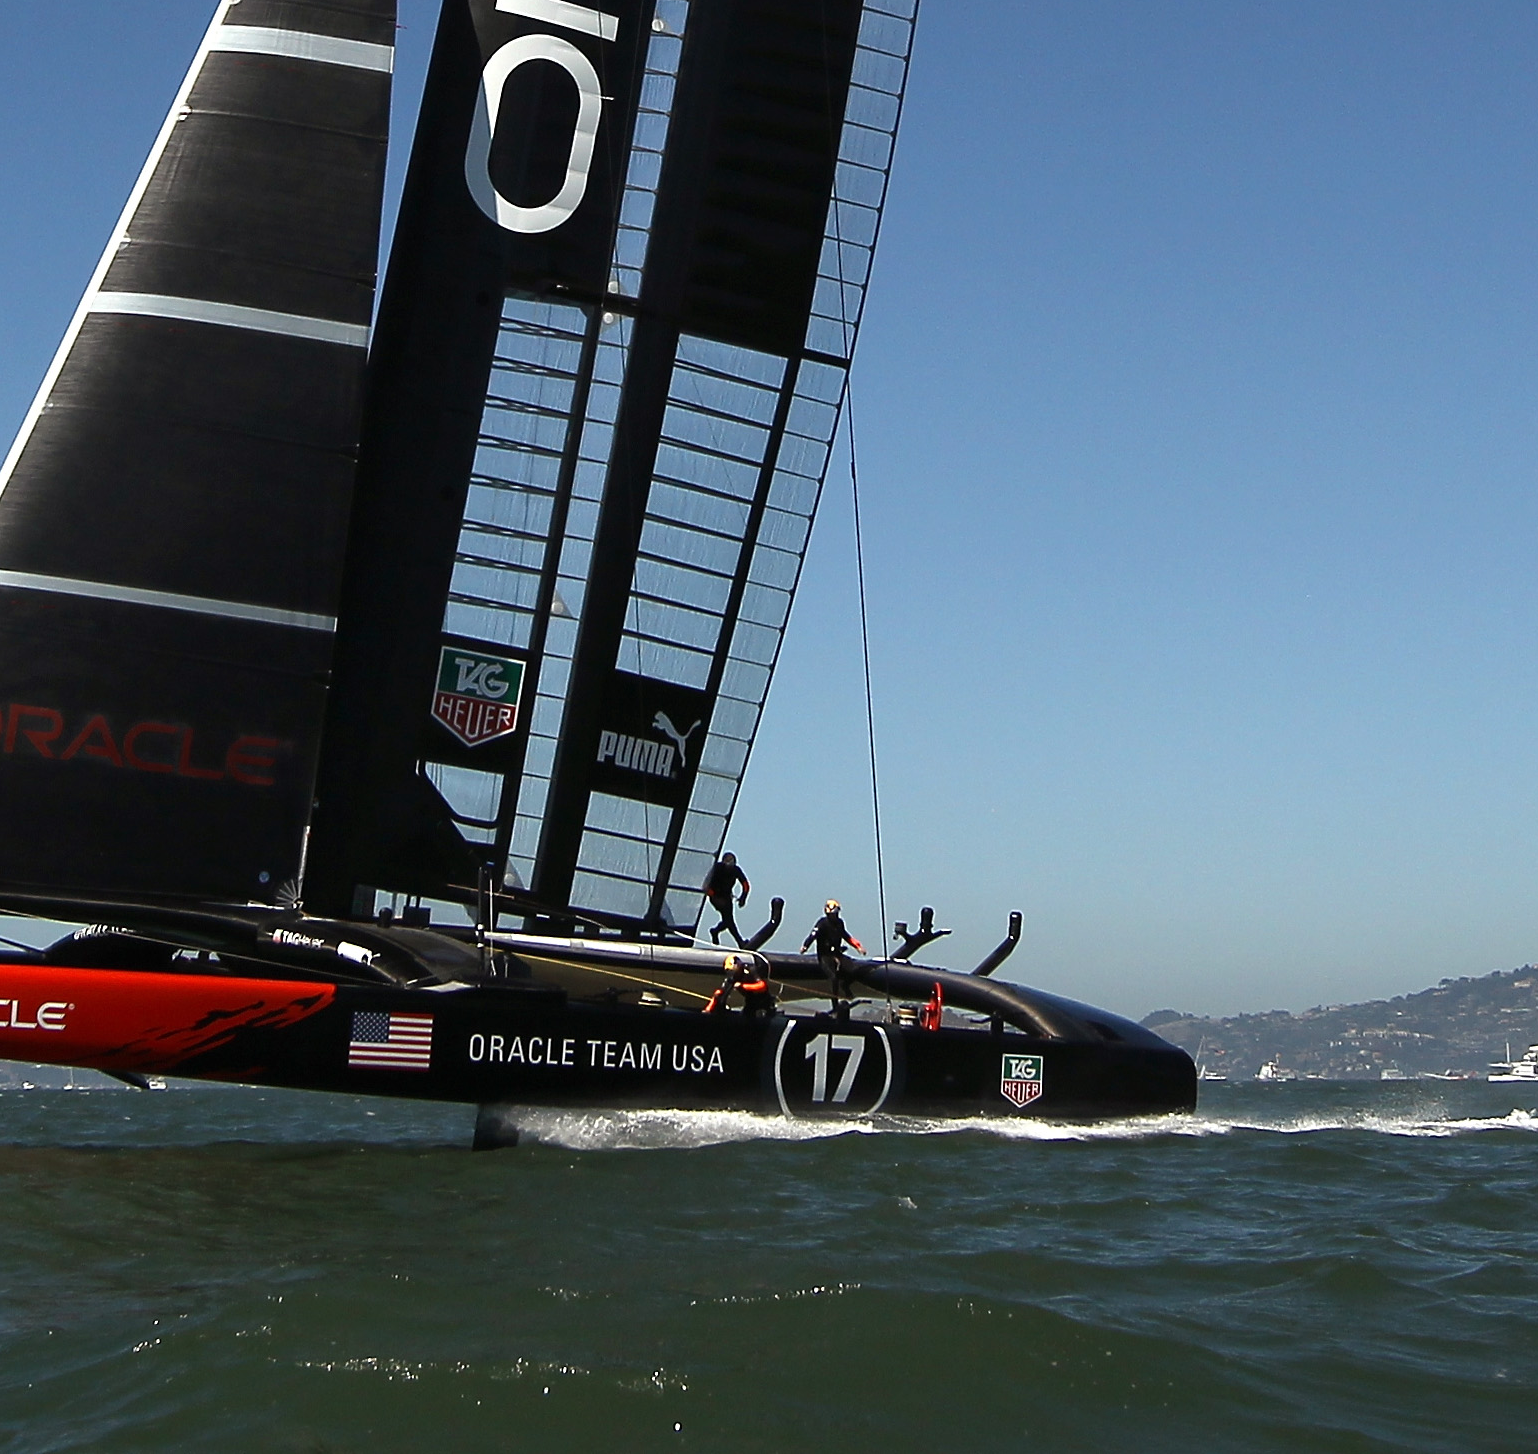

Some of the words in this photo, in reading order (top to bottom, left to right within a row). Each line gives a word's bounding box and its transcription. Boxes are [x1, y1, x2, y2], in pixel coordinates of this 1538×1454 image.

[455, 657, 509, 698] TAG
[439, 697, 512, 738] HEUER
[597, 730, 675, 778] PUMA
[469, 1033, 575, 1065] ORACLE
[587, 1039, 662, 1071] TEAM
[672, 1045, 724, 1074] USA
[804, 1033, 866, 1103] 17
[1009, 1058, 1037, 1079] TAG
[1004, 1081, 1039, 1103] HEUER
